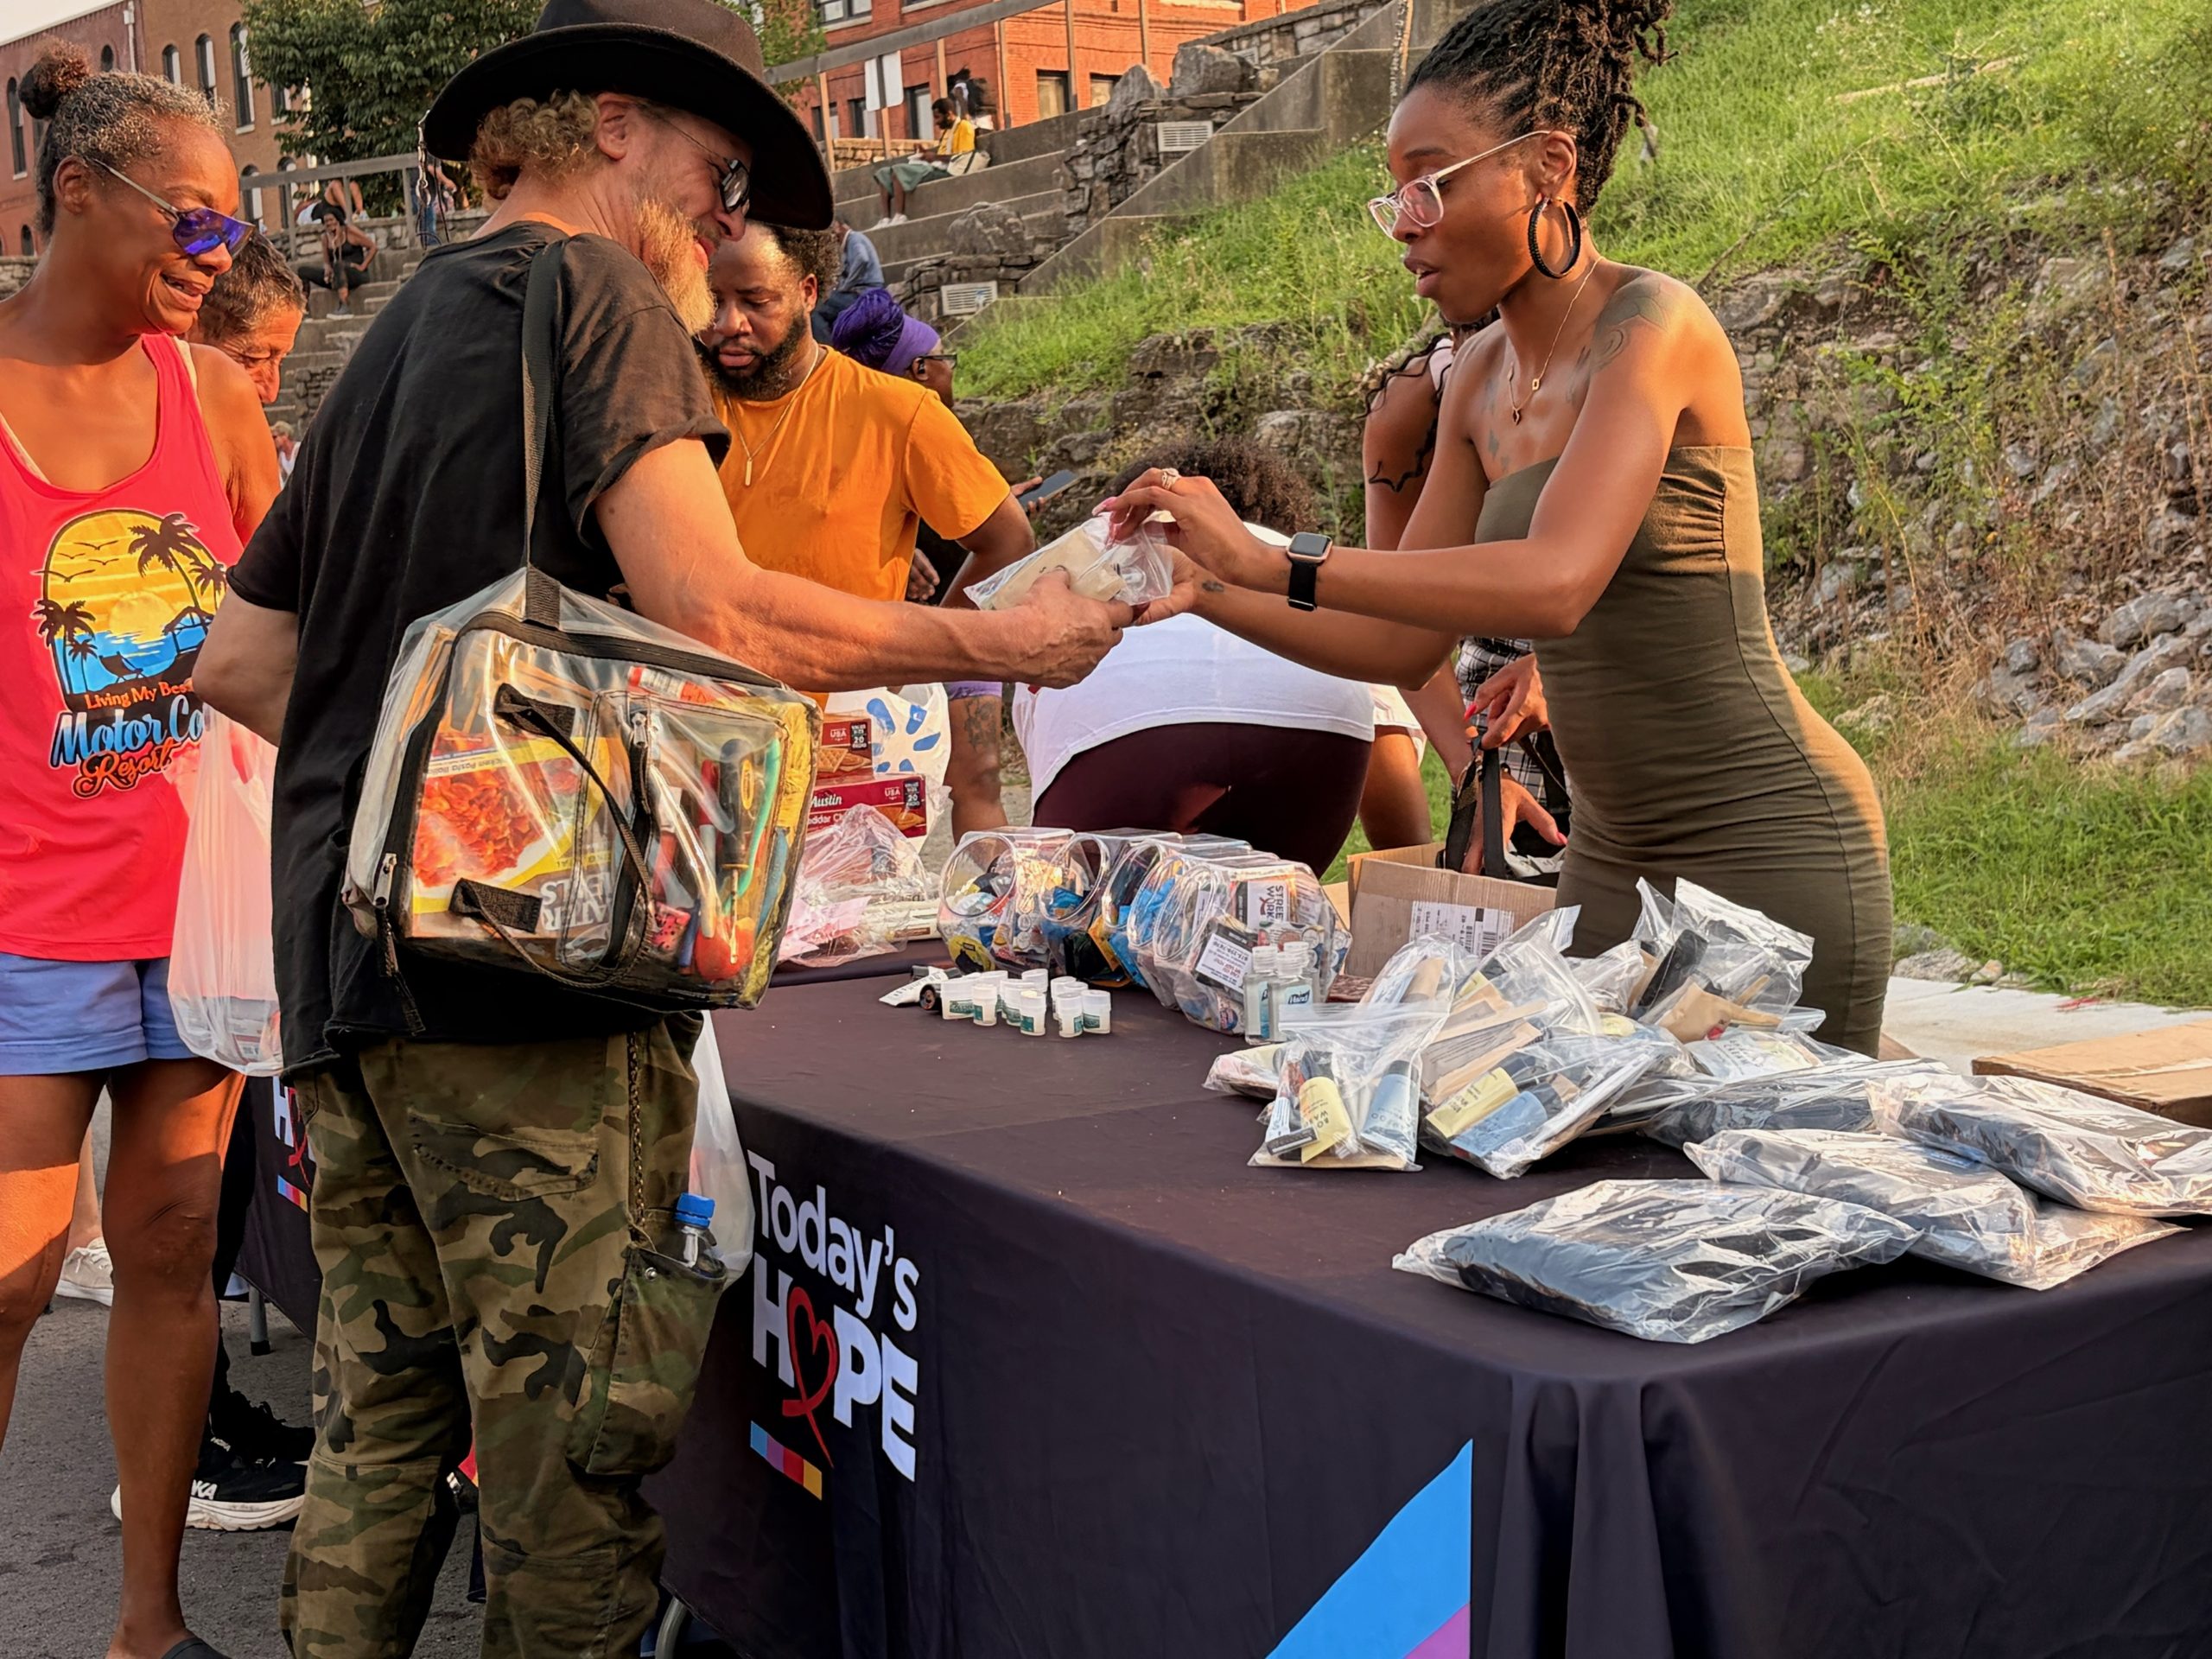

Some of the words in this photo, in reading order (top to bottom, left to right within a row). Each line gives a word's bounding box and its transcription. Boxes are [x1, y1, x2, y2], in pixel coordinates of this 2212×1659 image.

[84, 691, 130, 709] Living
[132, 686, 157, 702] My
[50, 709, 168, 767] Motor
[169, 694, 204, 743] Co
[830, 728, 847, 738] USA
[73, 737, 181, 798] Resort
[812, 793, 842, 808] Austin
[885, 788, 900, 797] USA
[747, 1149, 919, 1332] Today's
